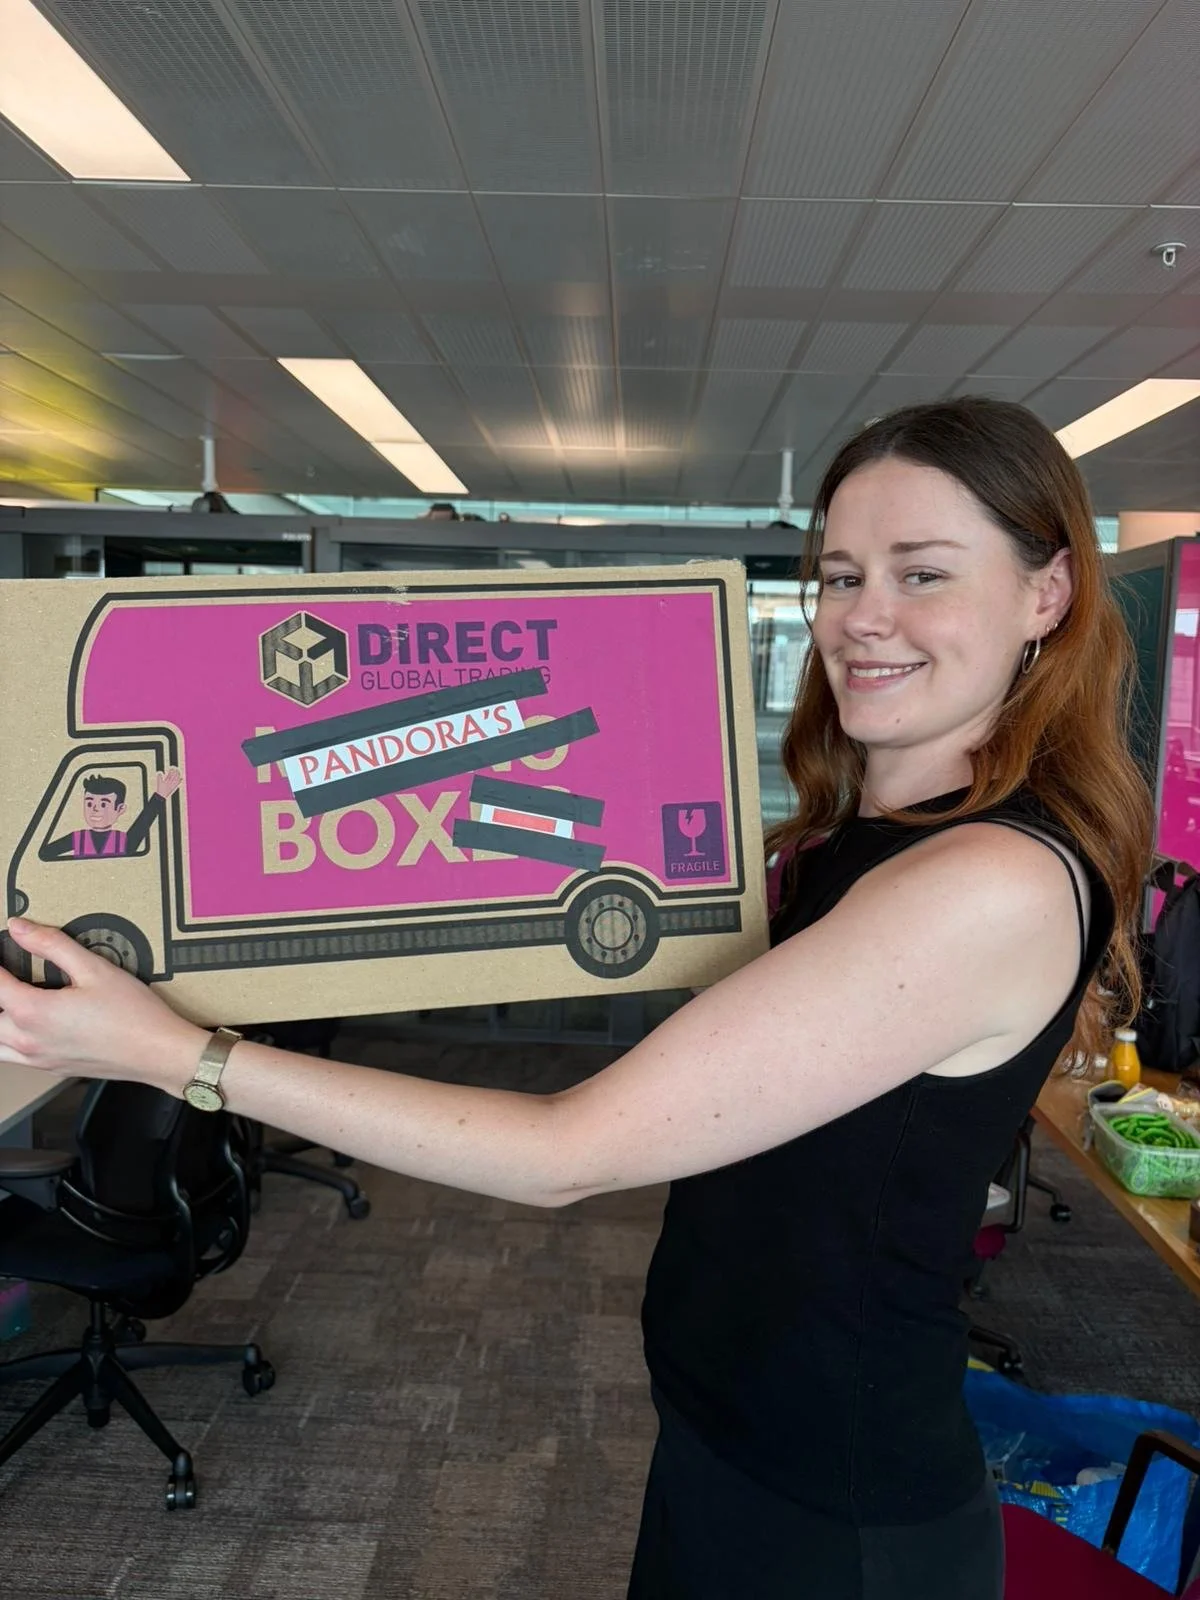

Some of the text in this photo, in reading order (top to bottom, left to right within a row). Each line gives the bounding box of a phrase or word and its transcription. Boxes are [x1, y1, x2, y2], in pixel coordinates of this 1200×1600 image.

[357, 619, 558, 666] DIRECT
[360, 668, 450, 691] GLOBAL
[298, 705, 513, 786] PANDORA'S
[260, 786, 575, 875] BOX
[670, 860, 720, 873] FRAGILE
